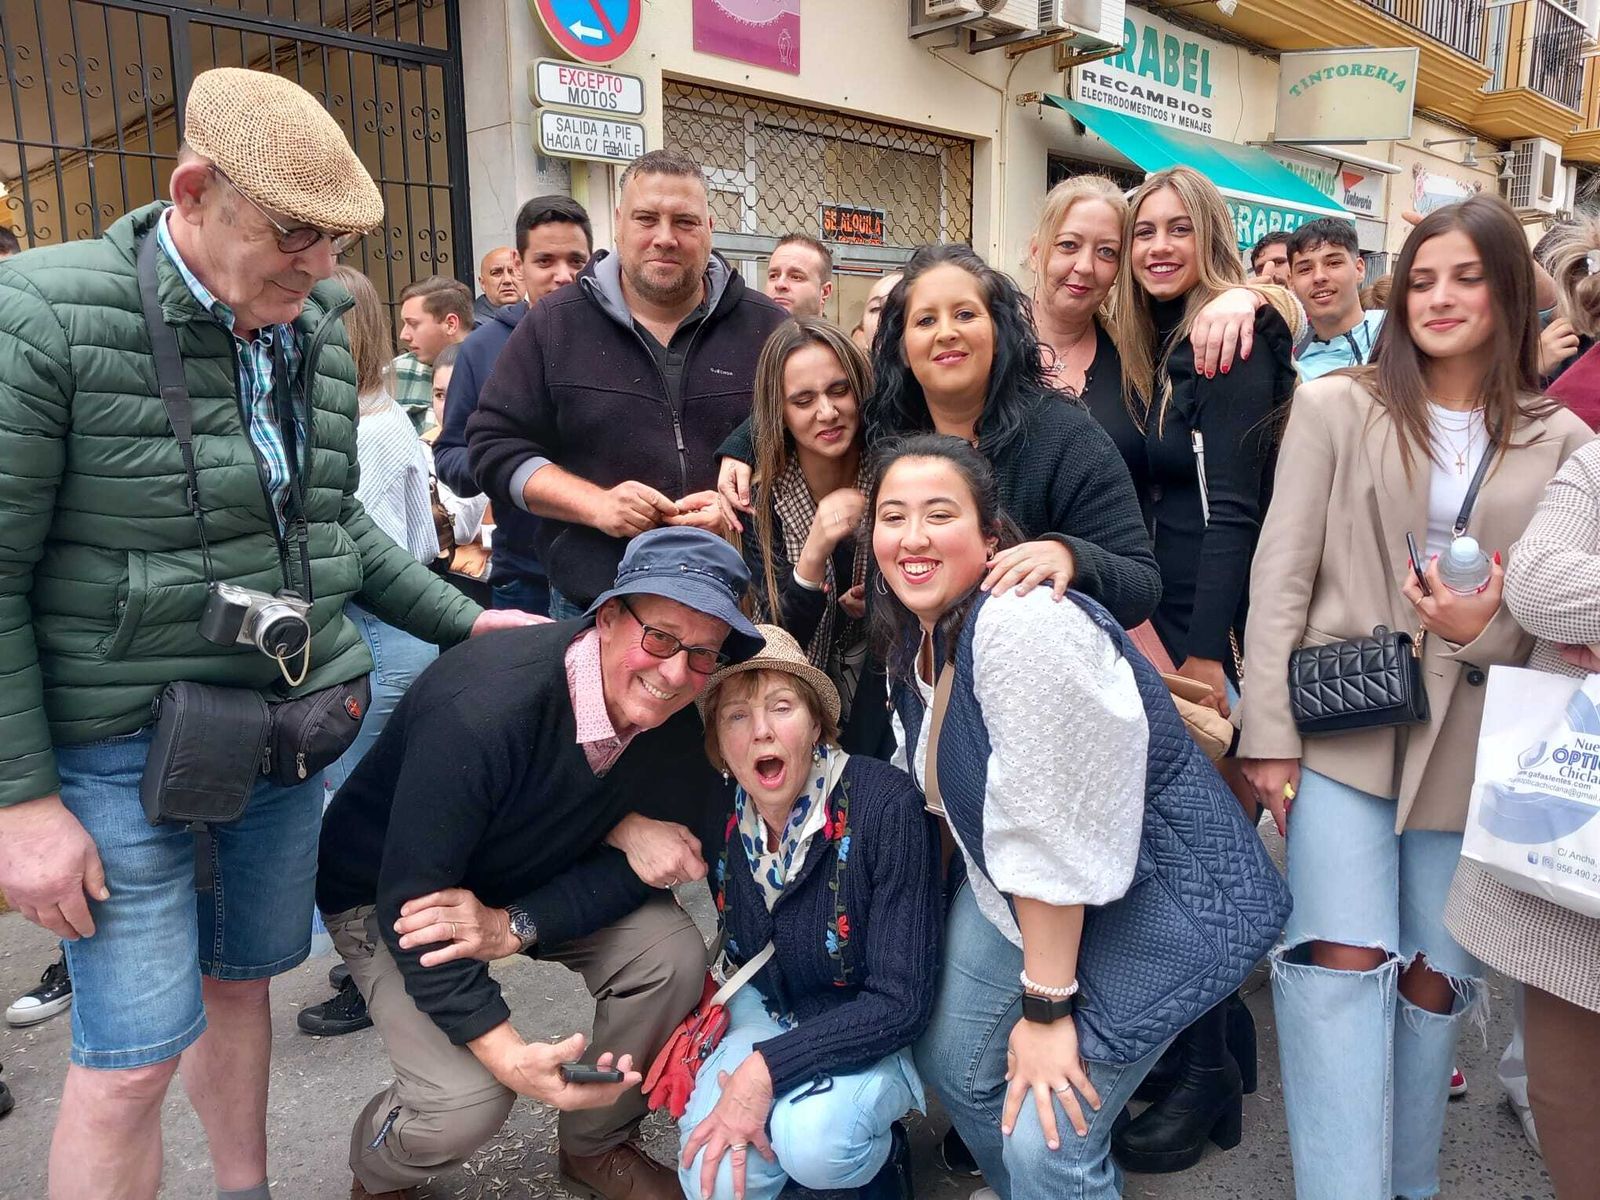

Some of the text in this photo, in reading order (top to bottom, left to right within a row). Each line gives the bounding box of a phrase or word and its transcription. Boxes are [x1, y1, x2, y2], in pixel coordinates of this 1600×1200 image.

[558, 67, 623, 93] EXCEPTO
[1288, 63, 1407, 97] TINTORERIA
[567, 86, 618, 109] MOTOS
[1082, 69, 1213, 119] RECAMBIOS
[1081, 86, 1212, 134] ELECTRODOMESTICOS Y MENAJES
[546, 132, 582, 151] HACIA
[585, 137, 598, 152] C/
[556, 117, 632, 141] SALIDA A PIE
[824, 209, 881, 235] SE ALQUILA
[1552, 744, 1600, 771] ÓPTI
[1556, 863, 1573, 875] 956
[1575, 869, 1591, 880] 490
